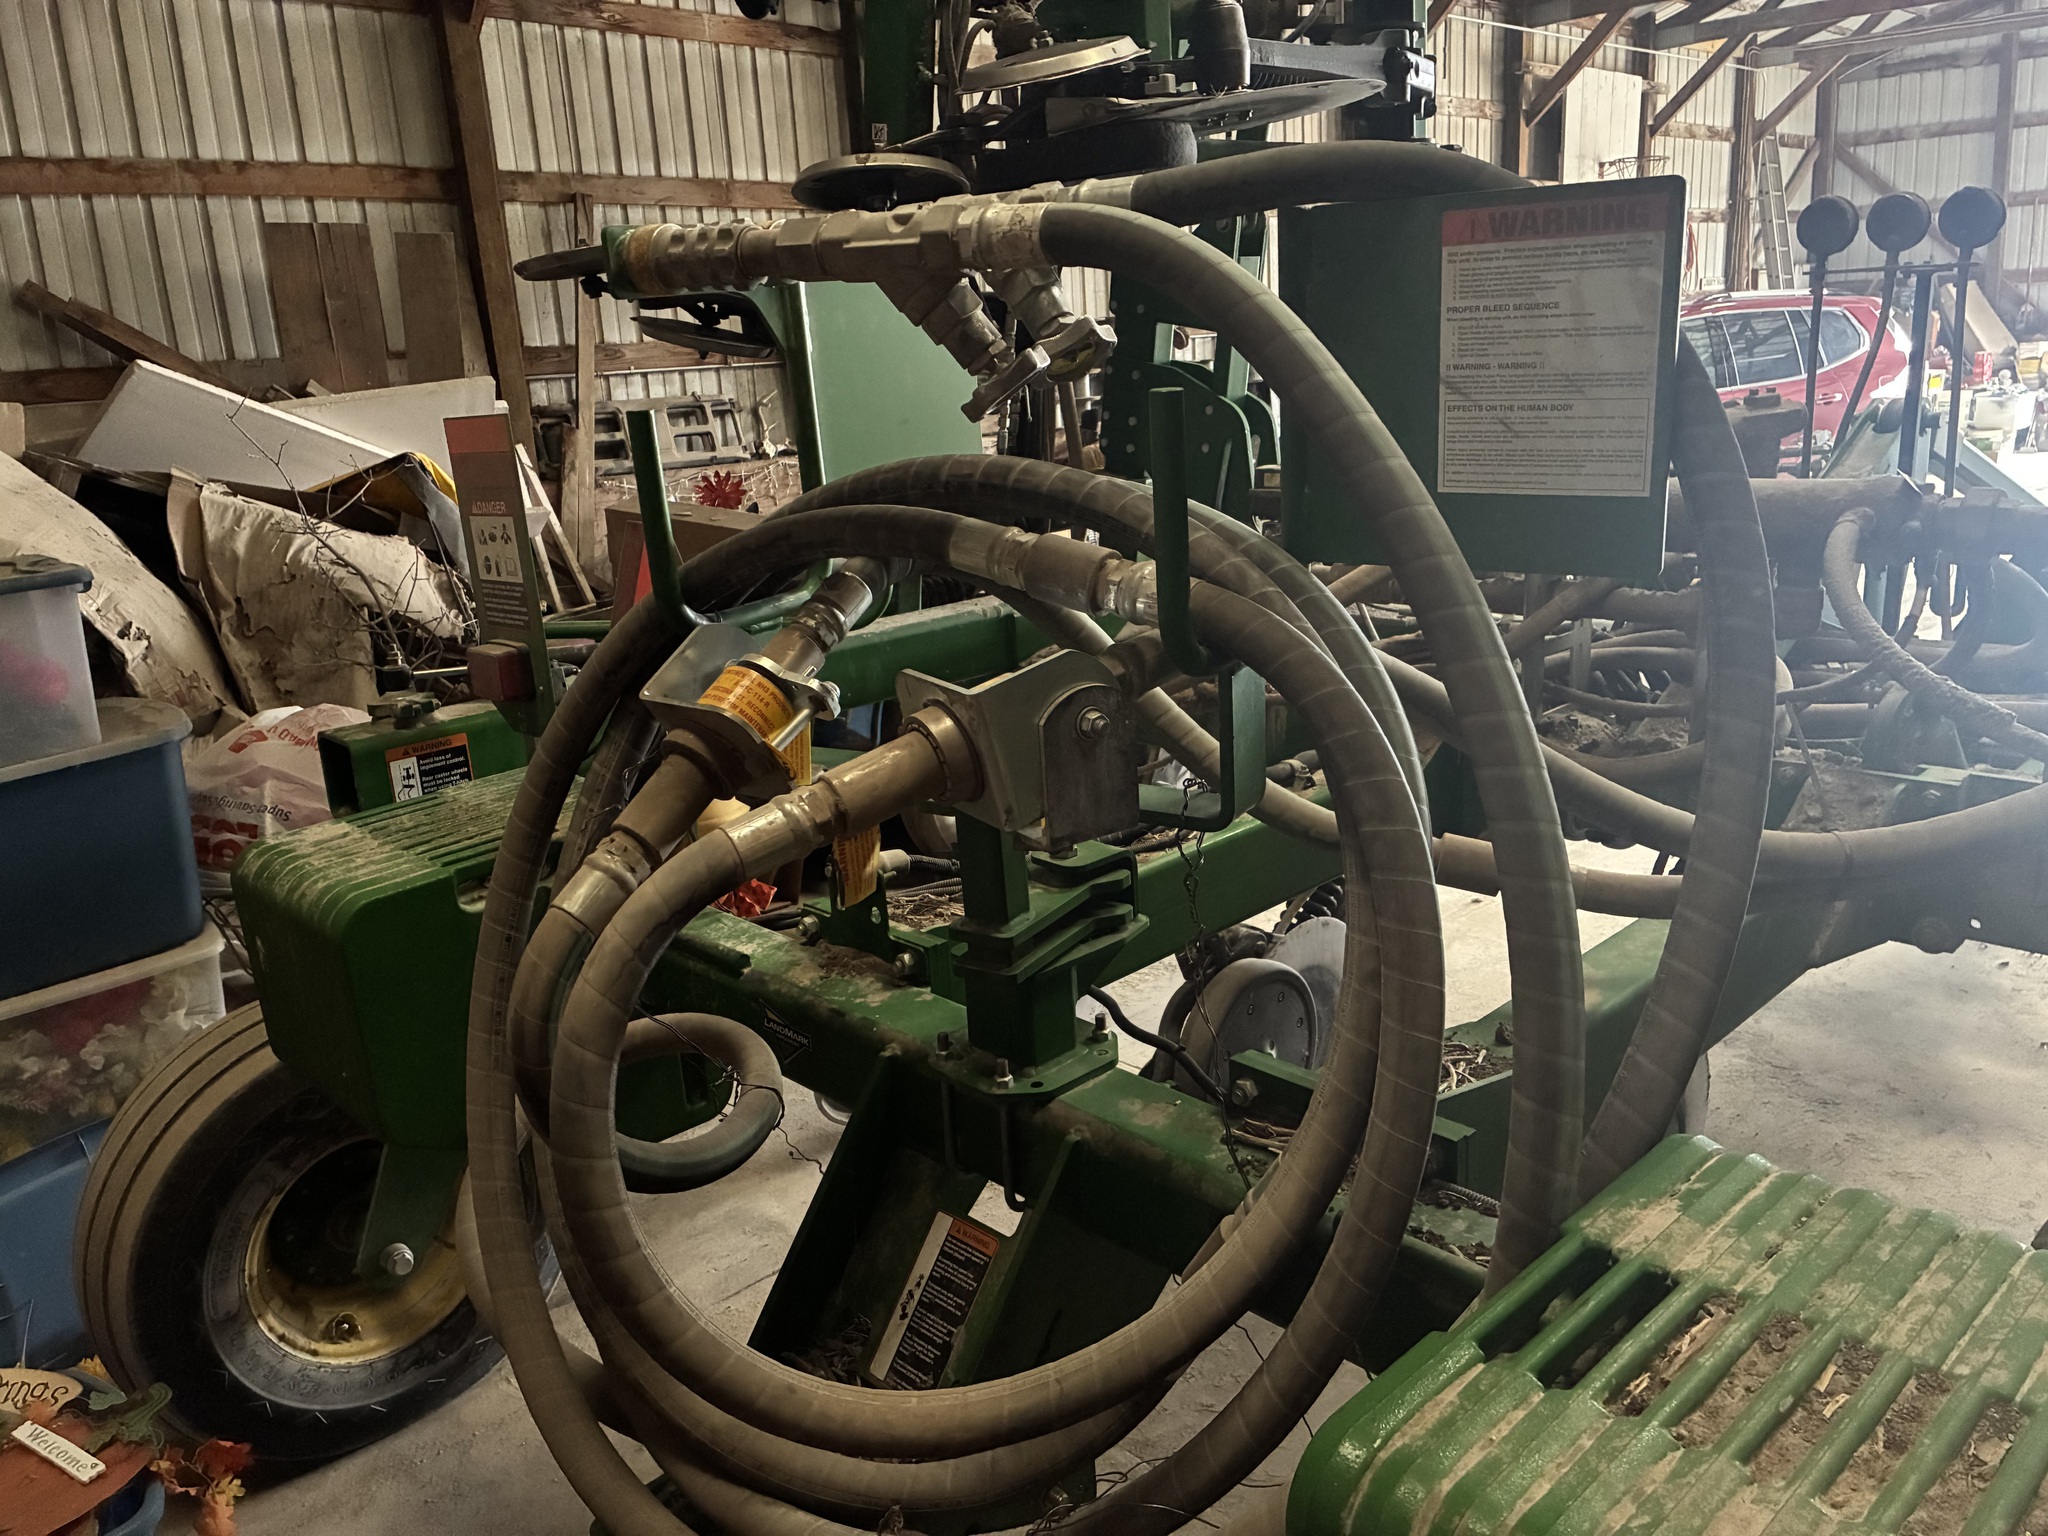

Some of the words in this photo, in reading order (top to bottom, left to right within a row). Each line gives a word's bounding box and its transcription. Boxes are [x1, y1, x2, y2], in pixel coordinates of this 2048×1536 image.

[1488, 200, 1651, 238] WARNING
[1446, 304, 1481, 314] PROPER
[1482, 302, 1511, 312] BLEED
[1512, 300, 1560, 311] SEQUENCE
[1452, 362, 1491, 371] WARNING
[1497, 361, 1537, 370] WARNING
[1447, 404, 1483, 413] EFFECTS
[1484, 403, 1498, 413] ON
[1498, 403, 1515, 412] THE
[1516, 403, 1548, 412] HUMAN
[1549, 403, 1574, 412] BODY
[476, 501, 507, 514] DANGER
[756, 681, 771, 694] NH3
[412, 738, 452, 753] WARNING
[256, 803, 293, 822] Super
[961, 1229, 991, 1250] WARNING
[25, 1426, 89, 1473] Welcome
